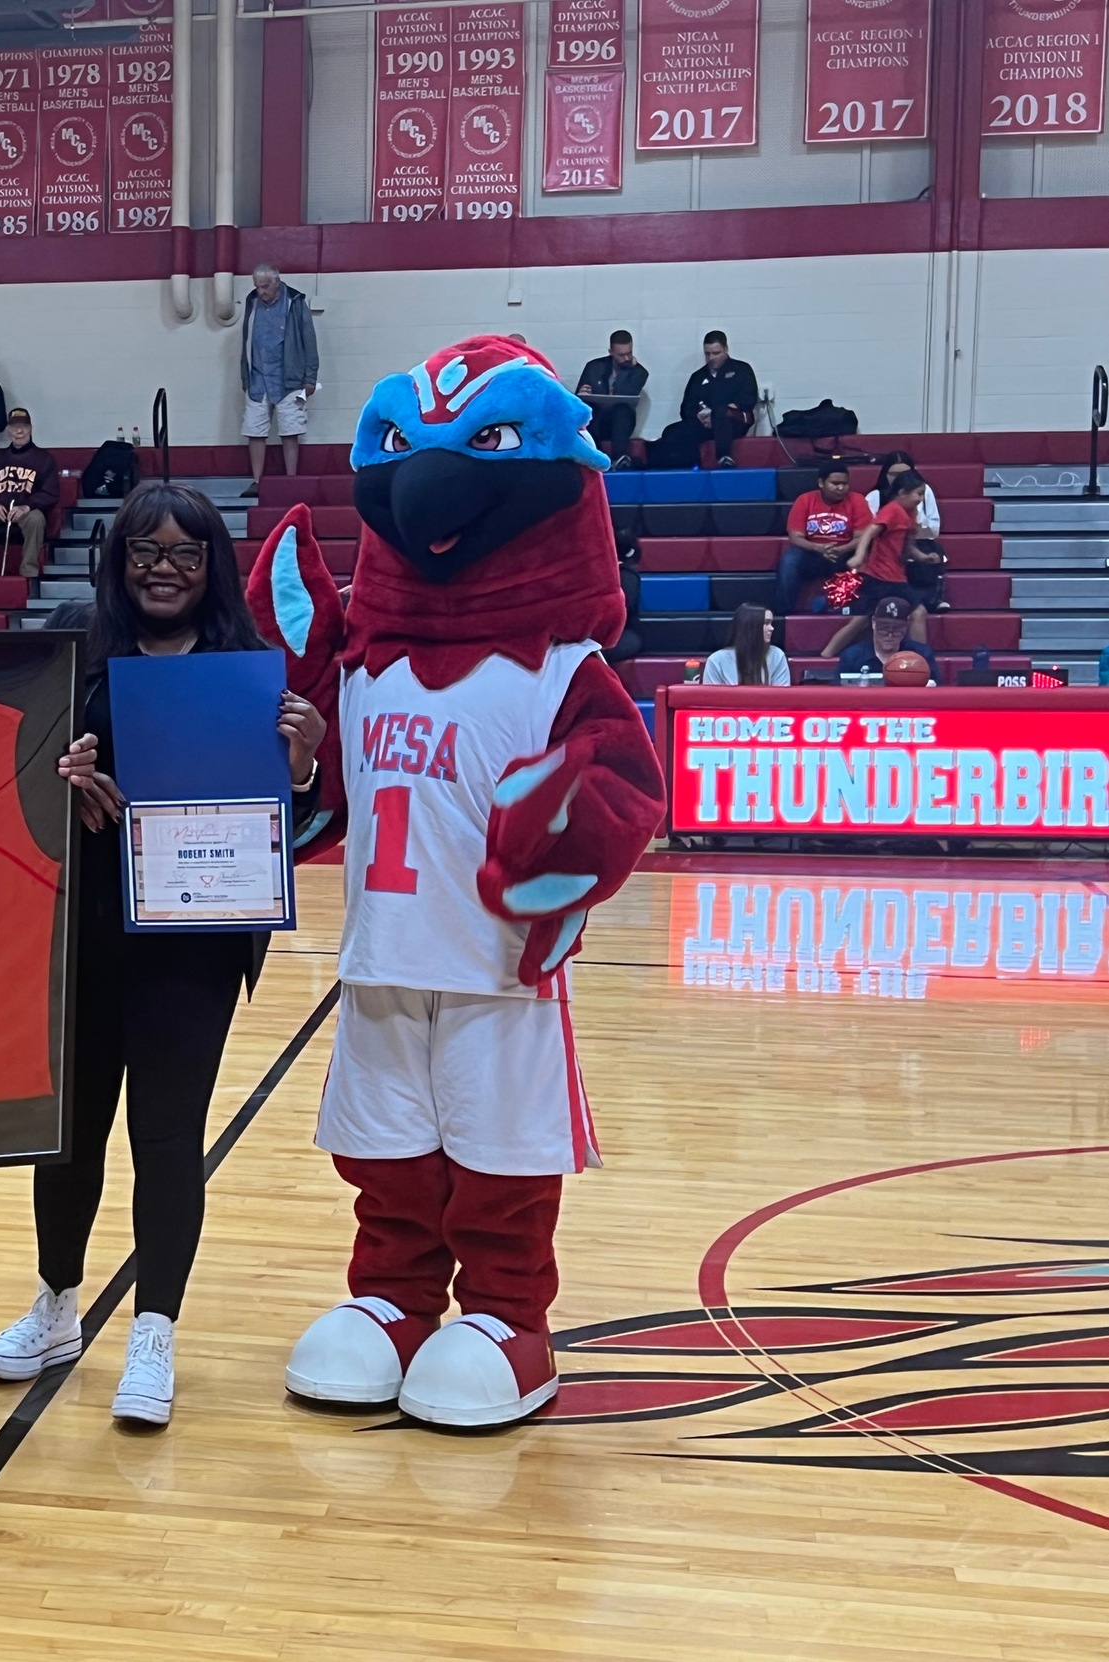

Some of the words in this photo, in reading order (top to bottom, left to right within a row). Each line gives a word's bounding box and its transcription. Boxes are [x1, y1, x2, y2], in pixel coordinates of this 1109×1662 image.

[569, 0, 606, 10] ACCAC
[396, 12, 432, 23] ACCAC
[468, 8, 506, 20] ACCAC
[558, 11, 610, 22] DIVISION
[386, 22, 436, 36] DIVISION
[458, 20, 510, 32] DIVISION
[554, 20, 620, 34] CHAMPIONS
[380, 34, 448, 46] CHAMPIONS
[453, 30, 520, 43] CHAMPIONS
[677, 32, 719, 43] NJCAA
[814, 30, 854, 42] ACCAC
[860, 28, 914, 41] REGION
[986, 35, 1034, 50] ACCAC
[1036, 34, 1091, 47] REGION
[42, 48, 104, 59] CHAMPIONS
[556, 38, 616, 62] 1996
[662, 44, 723, 56] DIVISION
[830, 44, 892, 56] DIVISION
[385, 50, 444, 76] 1990
[458, 47, 516, 72] 1993
[664, 56, 732, 68] NATIONAL
[826, 56, 909, 70] CHAMPIONS
[1003, 51, 1068, 64] DIVISION
[47, 64, 101, 86] 1978
[116, 60, 172, 84] 1982
[643, 68, 752, 82] CHAMPIONSHIPS
[999, 66, 1084, 80] CHAMPIONS
[398, 78, 430, 88] MEN'S
[470, 74, 503, 86] MEN'S
[58, 88, 89, 98] MEN'S
[128, 83, 160, 93] MEN'S
[452, 86, 520, 98] BASKETBALL
[555, 84, 614, 94] BASKETBALL
[656, 84, 695, 95] SIXTH
[698, 82, 738, 93] PLACE
[380, 89, 446, 100] BASKETBALL
[42, 99, 105, 110] BASKETBALL
[990, 92, 1088, 128] 2018
[818, 99, 914, 134] 2017
[648, 106, 743, 142] 2017
[127, 168, 162, 178] ACCAC
[392, 166, 429, 176] ACCAC
[466, 162, 504, 173] ACCAC
[56, 174, 90, 183] ACCAC
[382, 176, 433, 188] DIVISION
[455, 174, 506, 184] DIVISION
[560, 168, 605, 186] 2015
[46, 184, 94, 194] DIVISION
[116, 178, 166, 190] DIVISION
[450, 184, 518, 196] CHAMPIONS
[377, 187, 442, 198] CHAMPIONS
[42, 194, 102, 205] CHAMPIONS
[380, 204, 438, 222] 1997
[454, 200, 513, 220] 1999
[46, 210, 100, 232] 1986
[116, 206, 172, 228] 1987
[998, 676, 1026, 688] POSS
[688, 716, 794, 742] HOME
[802, 717, 851, 743] OF
[860, 717, 937, 744] THE
[360, 712, 459, 784] MESA
[688, 748, 1109, 828] THUNDERBIR
[364, 785, 419, 895] 1
[178, 848, 207, 860] ROBERT
[210, 848, 235, 858] SMITH
